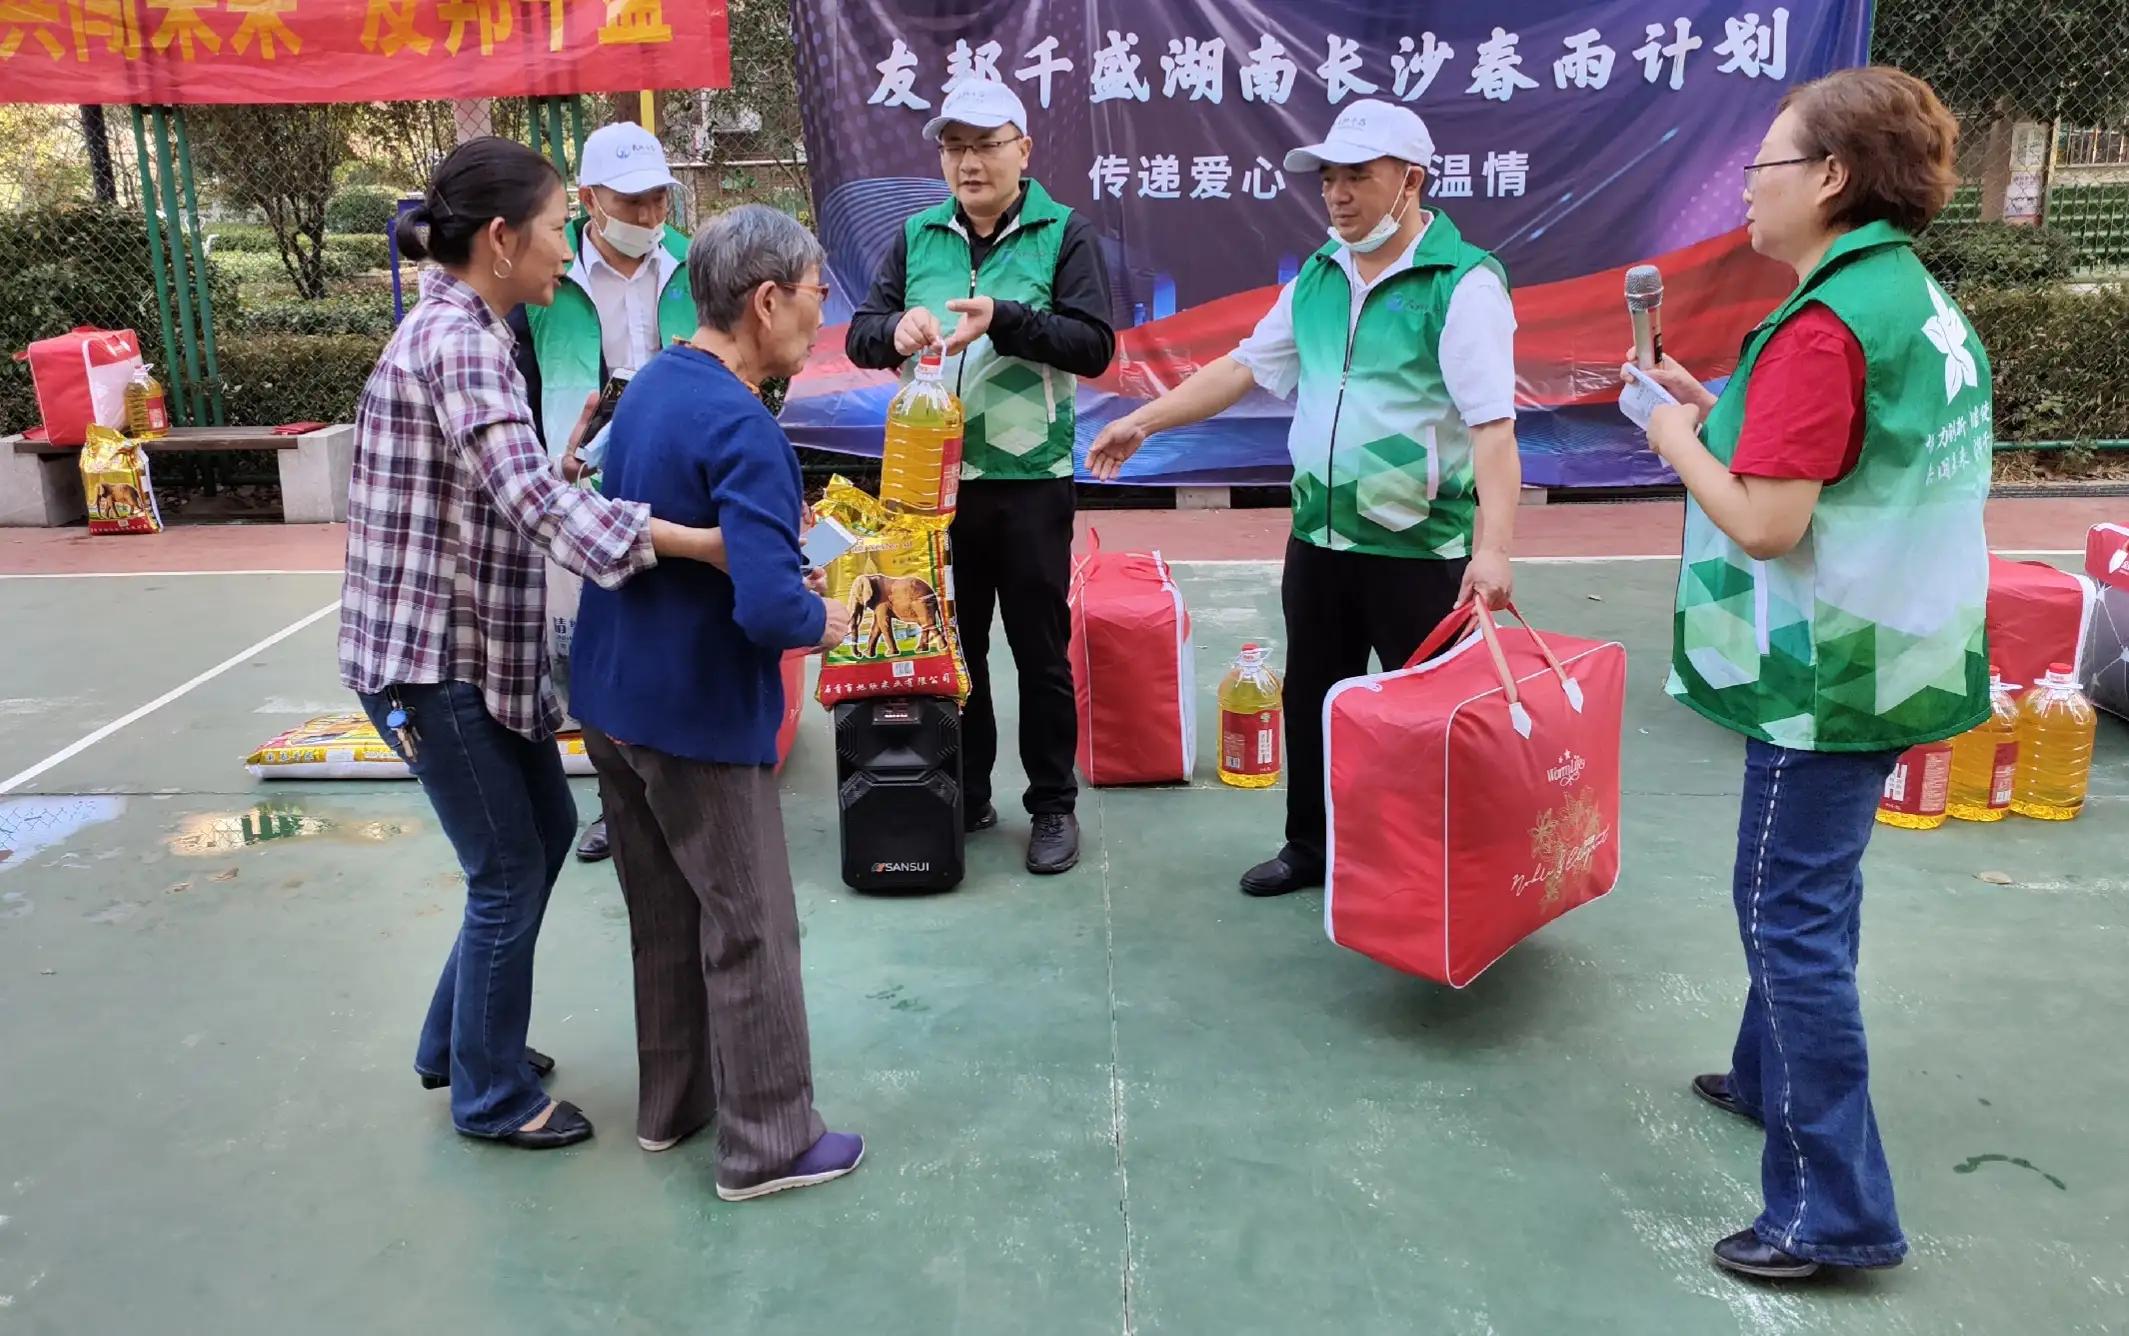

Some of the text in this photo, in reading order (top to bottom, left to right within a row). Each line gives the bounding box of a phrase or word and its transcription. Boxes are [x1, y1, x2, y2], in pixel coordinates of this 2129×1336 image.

[867, 7, 1789, 110] 友邦千盛湖南长沙春雨计划
[1088, 150, 1530, 201] 传递爱心 温情
[885, 862, 930, 872] SANSUI
